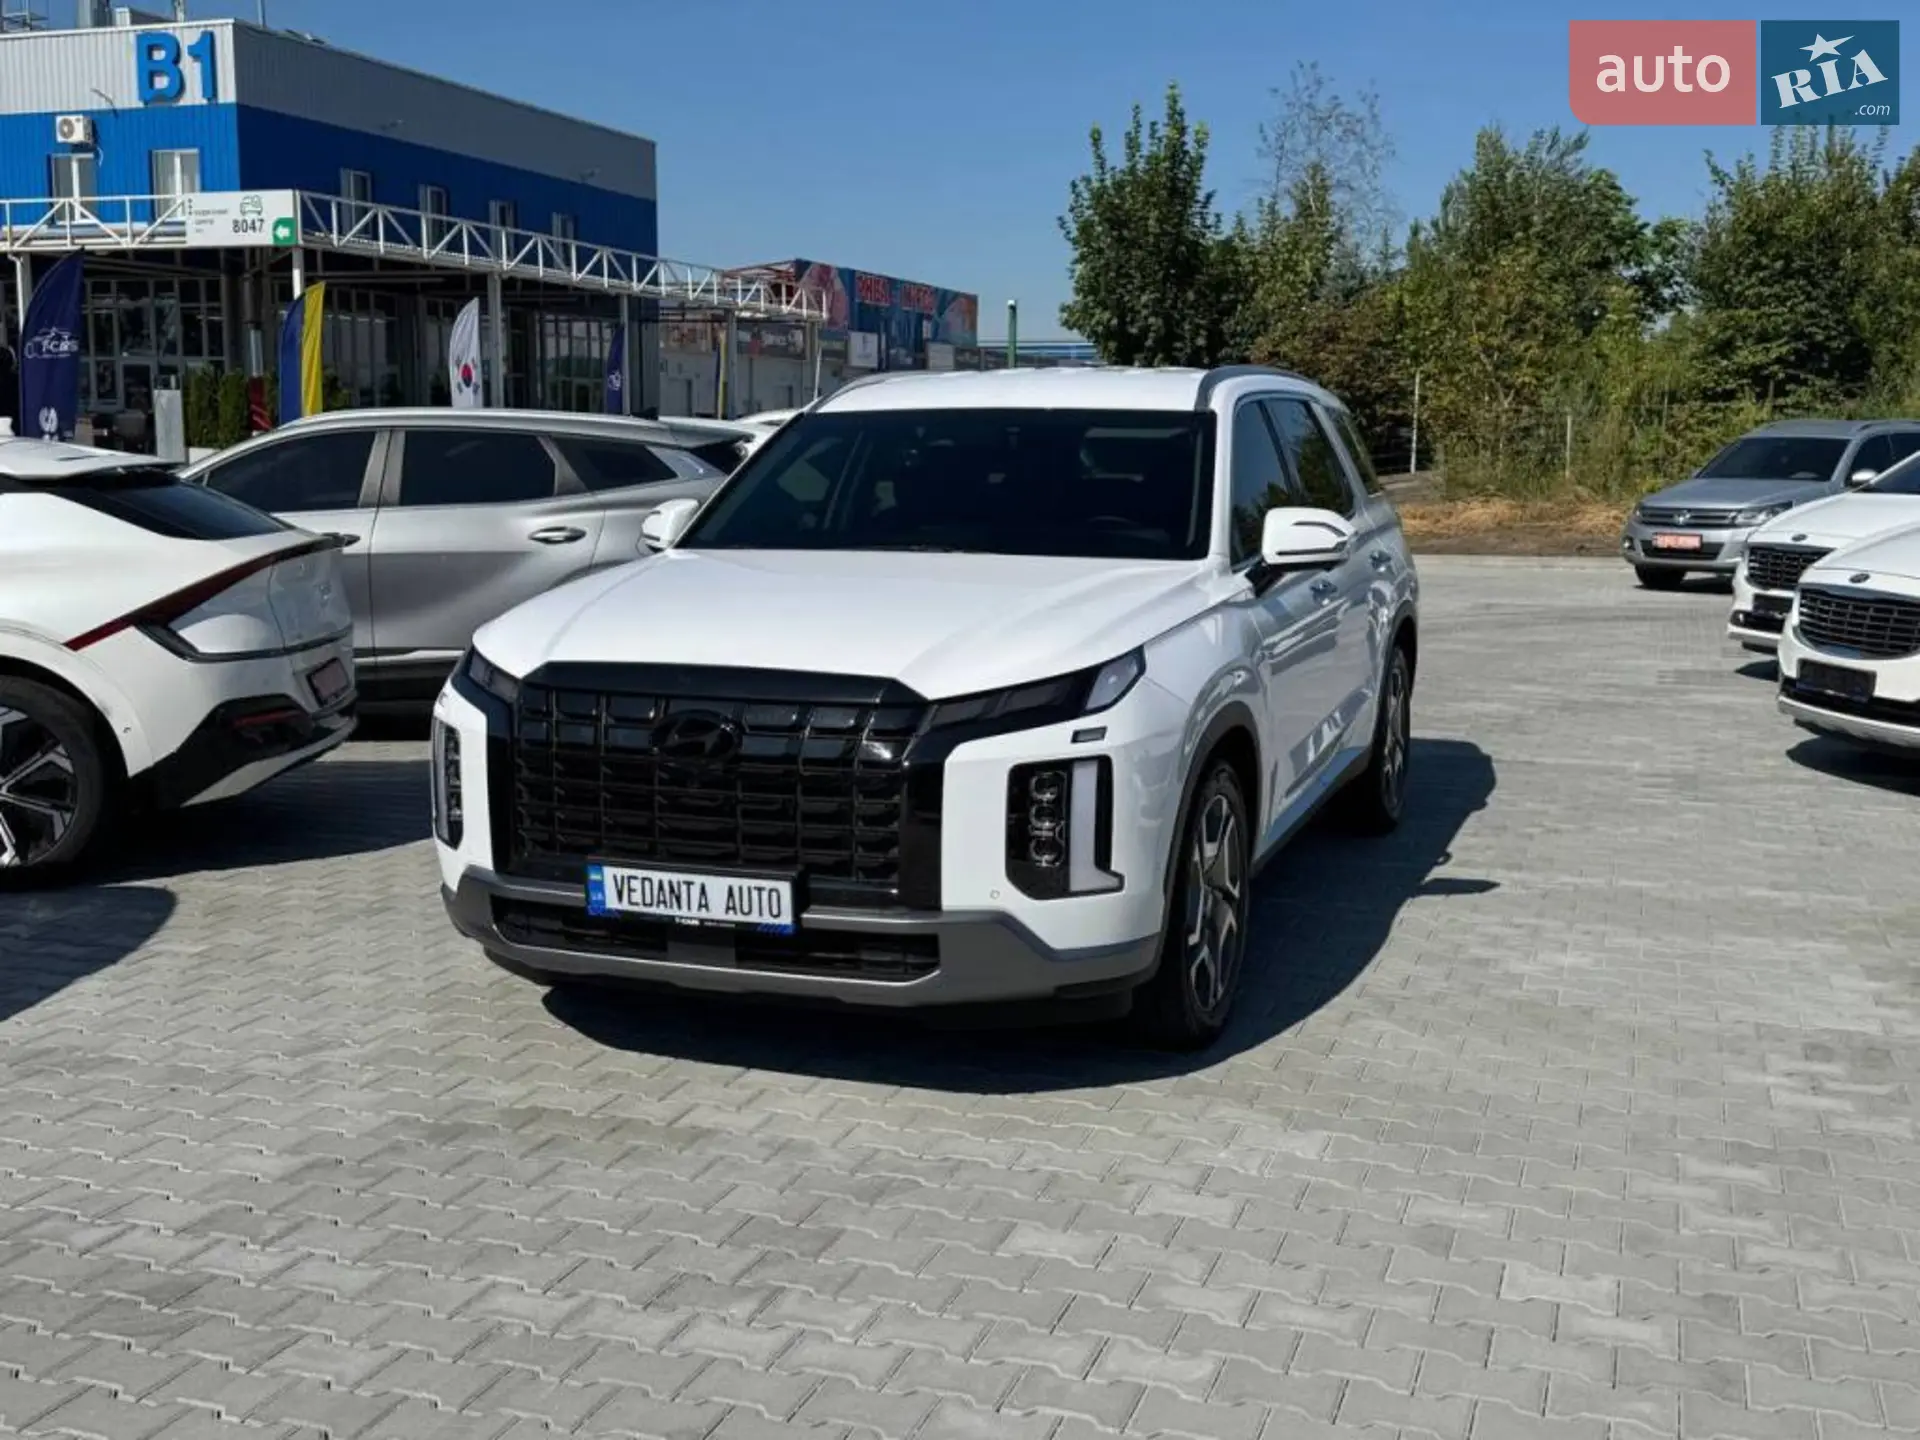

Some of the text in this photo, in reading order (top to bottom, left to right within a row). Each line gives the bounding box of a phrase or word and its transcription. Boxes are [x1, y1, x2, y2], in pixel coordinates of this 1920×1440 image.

[136, 30, 217, 103] B1
[232, 218, 265, 234] 8047
[613, 873, 782, 918] VEDANTA AUTO
